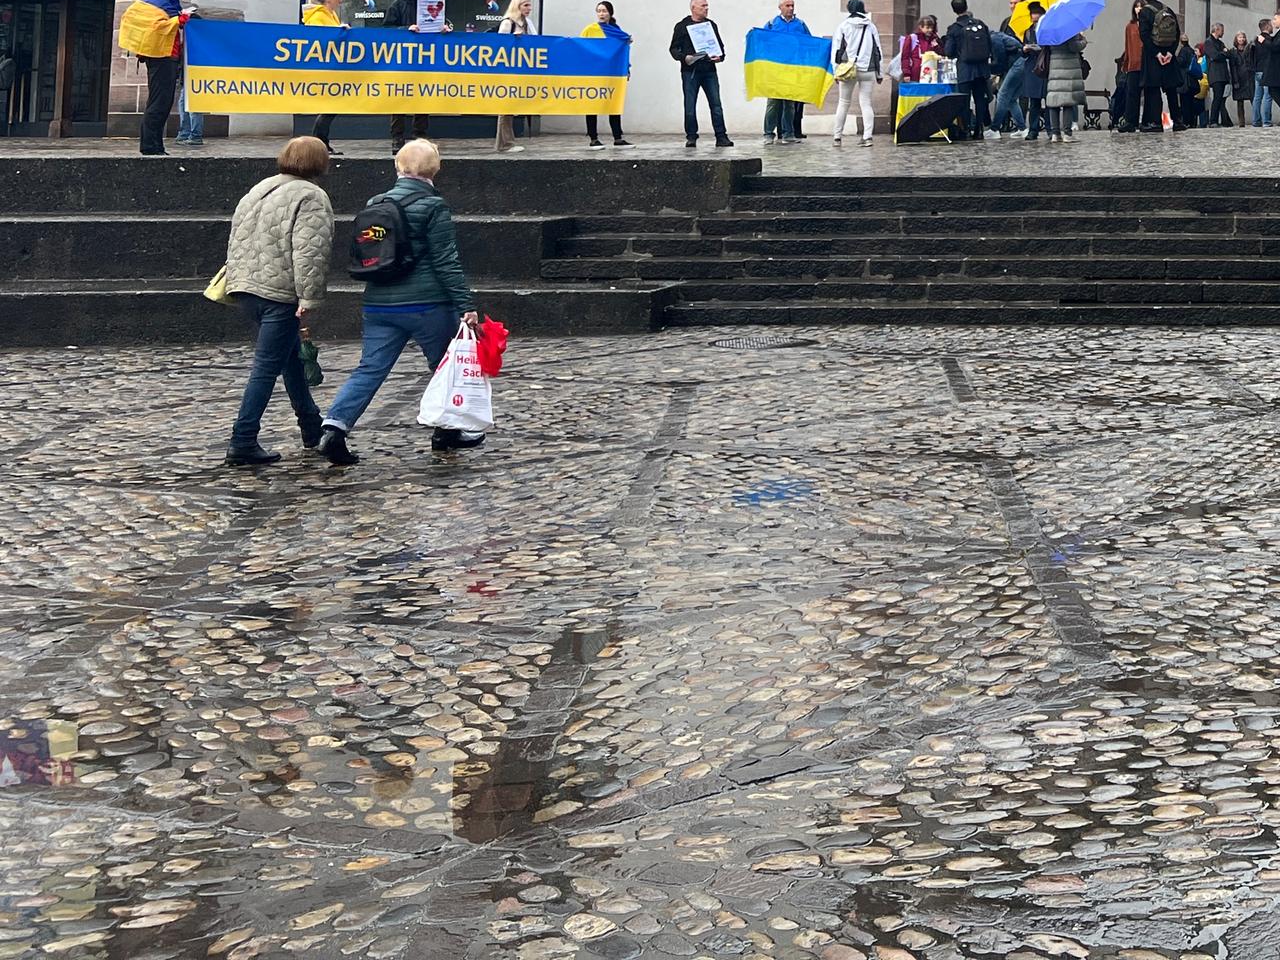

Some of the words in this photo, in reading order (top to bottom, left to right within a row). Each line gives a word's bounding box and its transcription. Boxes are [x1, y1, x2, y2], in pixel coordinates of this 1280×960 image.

[354, 11, 385, 19] swisscom
[475, 13, 505, 22] swissco
[273, 38, 366, 64] STAND
[372, 42, 436, 65] WITH
[443, 44, 549, 69] UKRAINE
[191, 79, 285, 96] UKRANIAN
[289, 81, 362, 97] VICTORY
[366, 83, 381, 97] IS
[384, 83, 414, 97] THE
[418, 83, 476, 98] WHOLE
[479, 85, 549, 100] WORLD'S
[552, 86, 616, 100] VICTORY
